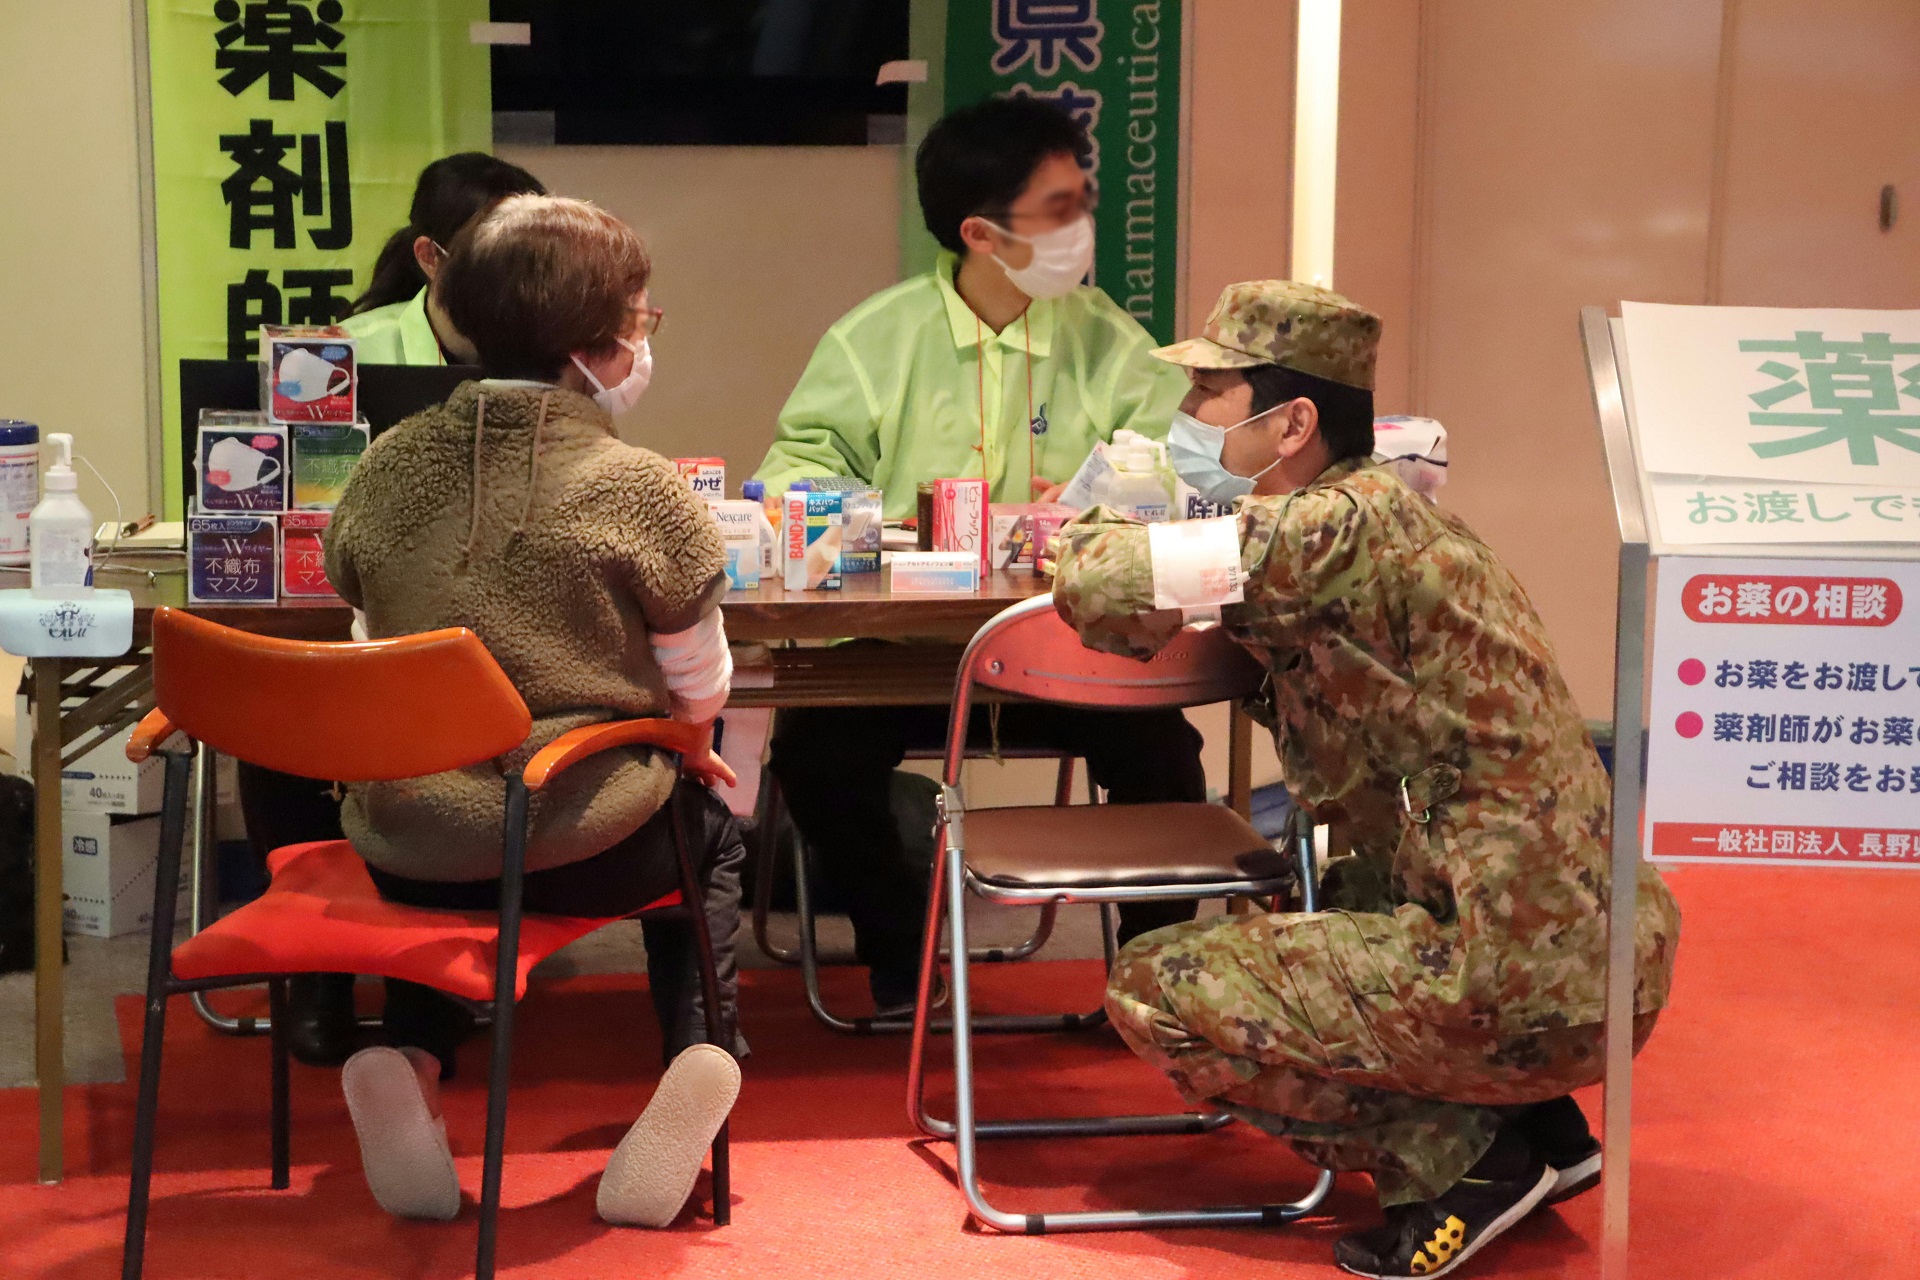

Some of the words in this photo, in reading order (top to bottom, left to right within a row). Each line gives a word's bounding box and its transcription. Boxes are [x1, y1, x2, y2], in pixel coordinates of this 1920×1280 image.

[1737, 330, 1920, 466] 薬
[692, 476, 724, 492] かぜ
[191, 518, 227, 532] 65枚入
[716, 511, 752, 523] Nexcare
[788, 500, 805, 559] BAND-AID
[204, 557, 261, 575] 不織布
[206, 577, 259, 593] マスク
[1698, 581, 1887, 620] お薬の相談
[1713, 712, 1920, 746] 薬剤師がお薬
[1691, 827, 1849, 855] 一般社団法人
